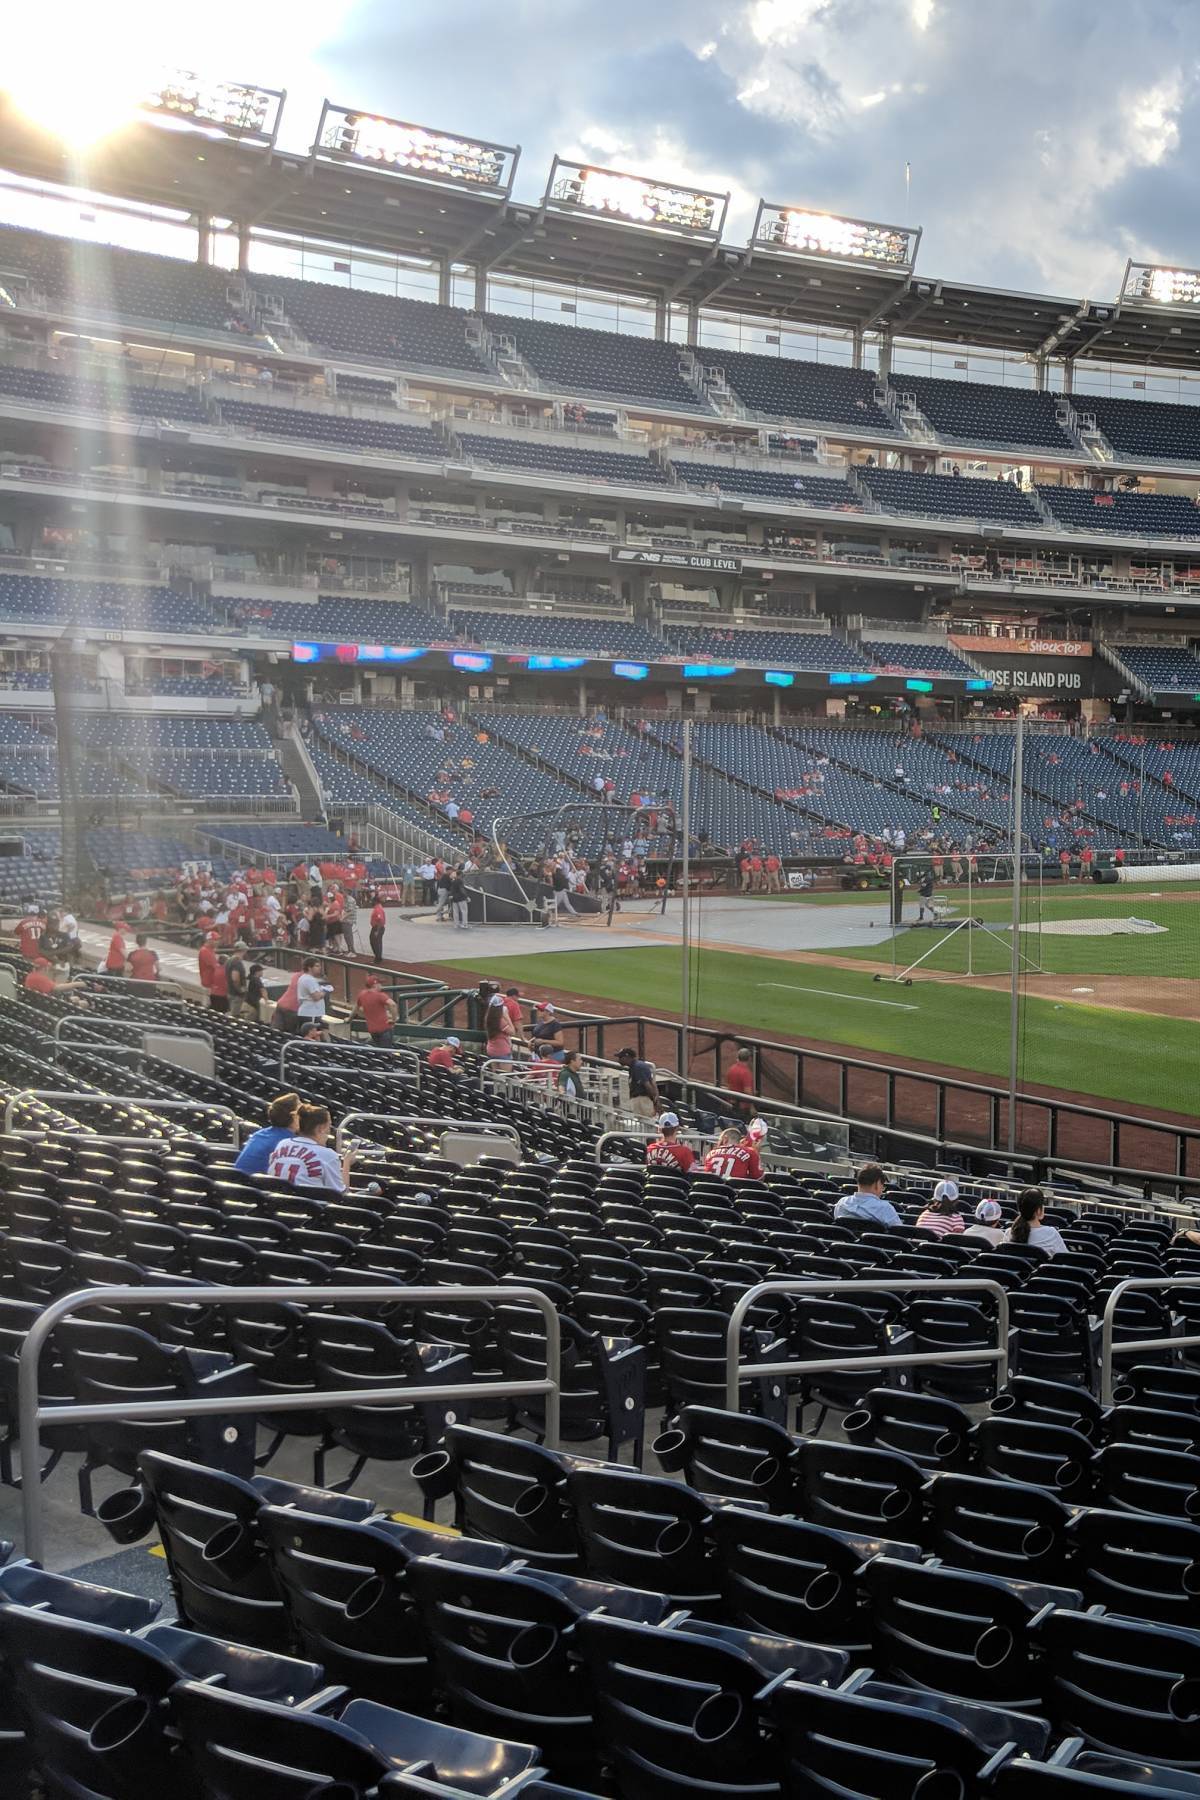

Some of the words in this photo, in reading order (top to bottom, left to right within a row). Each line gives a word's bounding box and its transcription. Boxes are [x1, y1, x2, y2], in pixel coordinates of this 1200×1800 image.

[691, 557, 711, 568] CLUB
[713, 559, 737, 570] LEVEL
[1029, 640, 1062, 653] SHOCK
[1062, 641, 1082, 655] TOP
[980, 669, 1010, 686] OOSE
[1013, 670, 1055, 688] ISLAND
[1057, 672, 1081, 689] PUB
[274, 1162, 300, 1184] 11
[711, 1157, 736, 1179] 31
